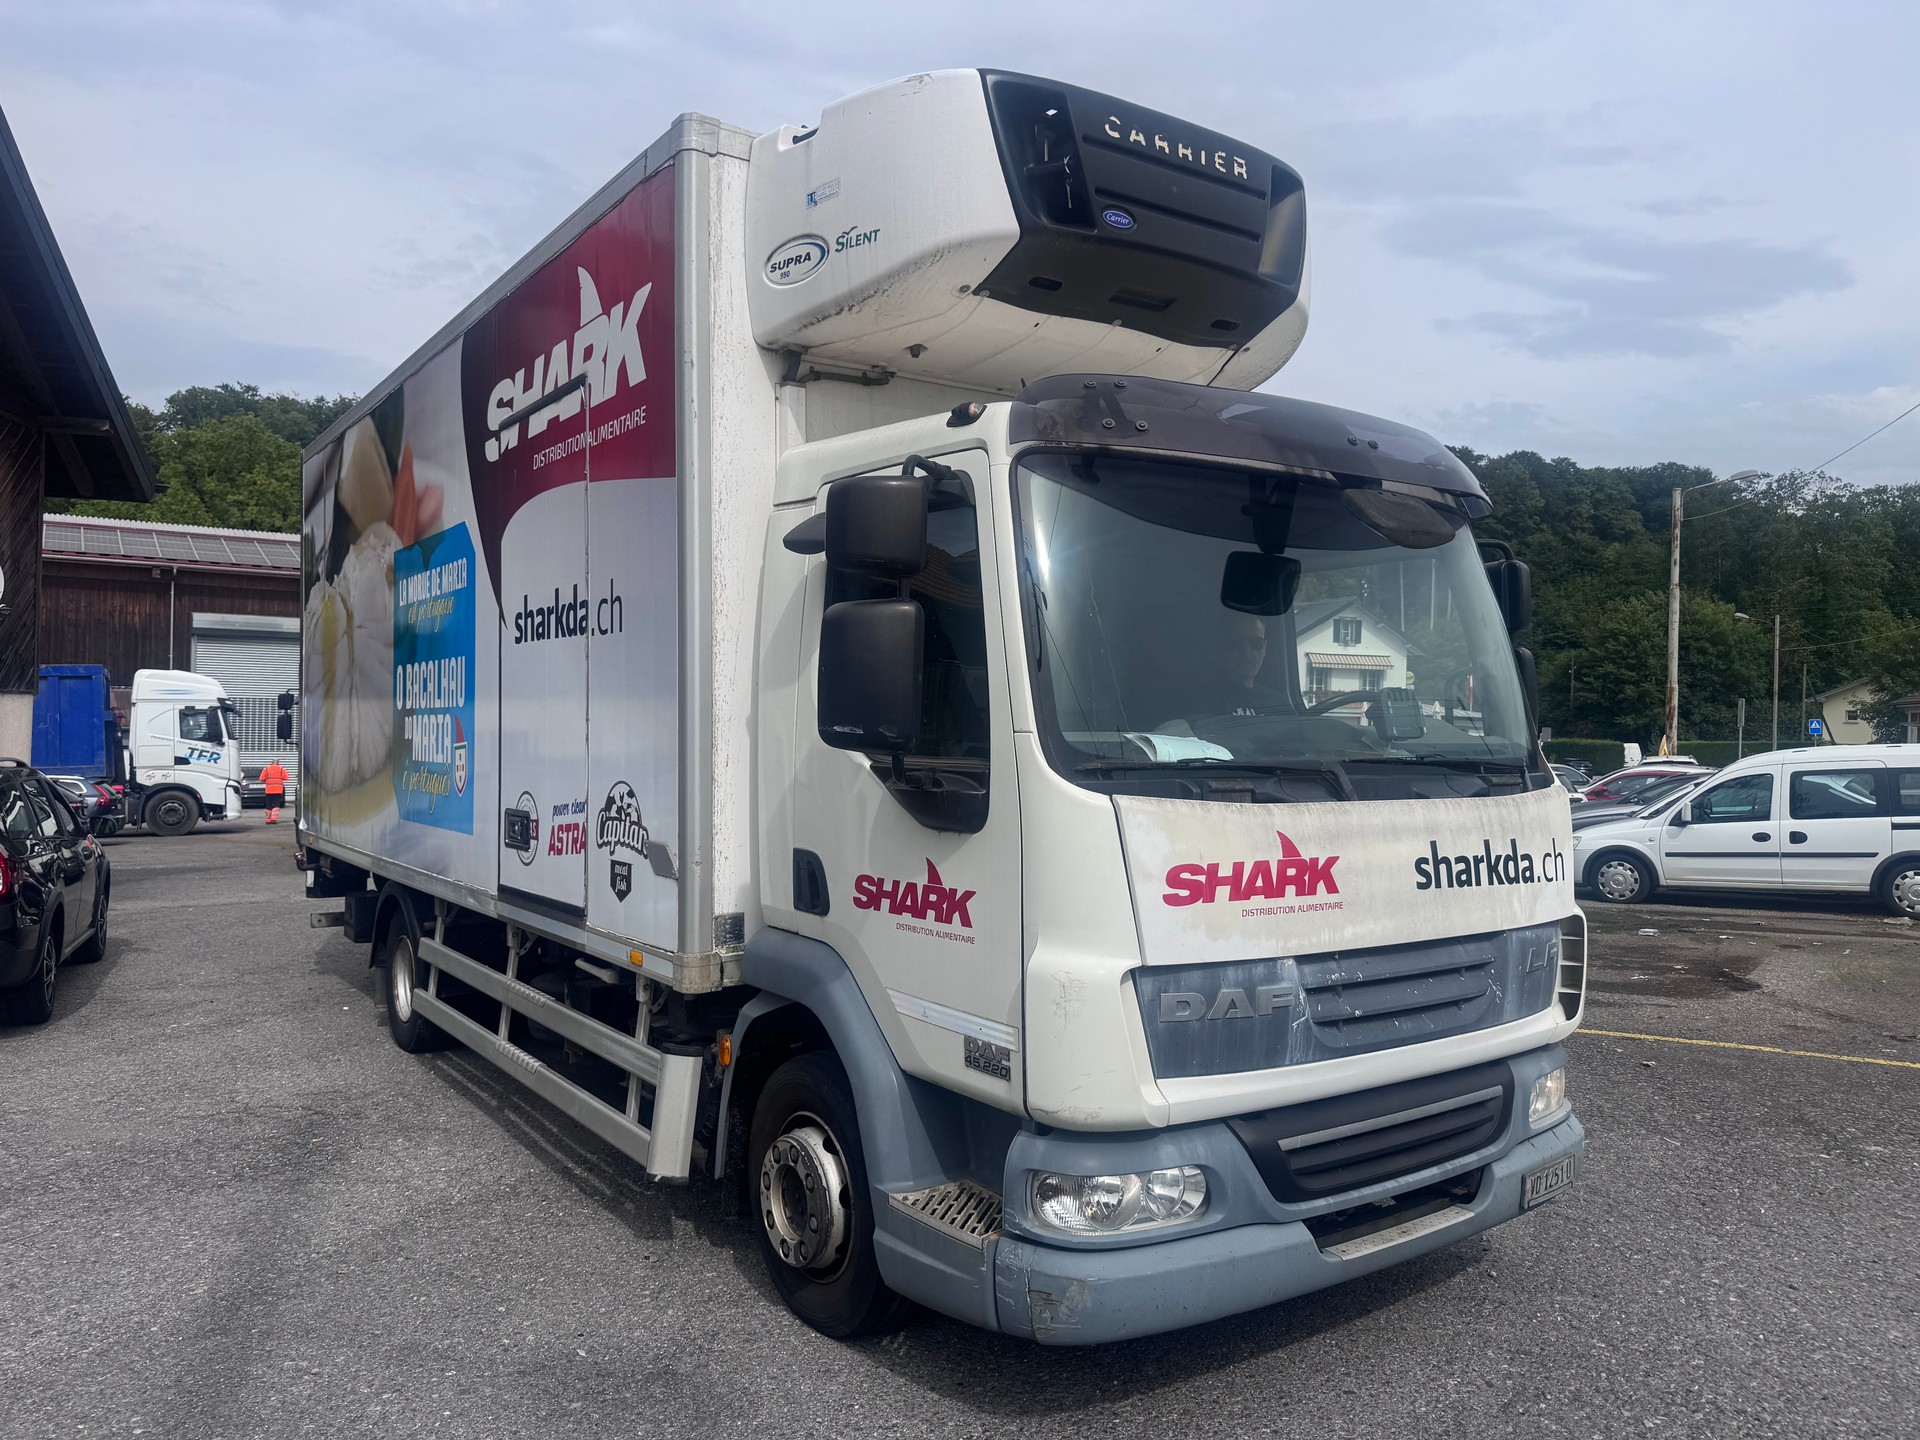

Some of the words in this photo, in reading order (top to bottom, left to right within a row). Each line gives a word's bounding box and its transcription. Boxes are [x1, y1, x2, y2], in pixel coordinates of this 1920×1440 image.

[1106, 213, 1130, 225] Carrier
[835, 227, 881, 253] SILENT
[769, 251, 812, 273] SUPRA
[780, 270, 791, 280] 950
[485, 280, 652, 463] SHARK
[533, 431, 587, 470] DISTRIBUTION
[587, 405, 647, 447] ALIMENTAIRE
[399, 578, 407, 607] LA
[408, 569, 430, 604] MORUE
[431, 566, 441, 597] DE
[441, 557, 467, 594] MARIA
[514, 577, 623, 645] sharkda.ch
[396, 664, 404, 711] O
[405, 655, 466, 710] BACALHAU
[412, 713, 452, 764] MARIA
[552, 802, 570, 823] power
[1414, 837, 1566, 891] sharkda.ch
[1162, 855, 1341, 907] SHARK
[852, 873, 977, 929] SHARK
[1241, 906, 1296, 918] DISTRIBUTION
[1297, 901, 1344, 913] ALIMENTAIRE
[896, 922, 935, 937] DISTRIBUTION
[934, 930, 976, 945] ALIMENTAIRE
[1159, 985, 1295, 1023] DAF
[964, 1035, 1011, 1062] DAF
[965, 1054, 1009, 1079] 45.220
[1530, 1174, 1542, 1197] VD
